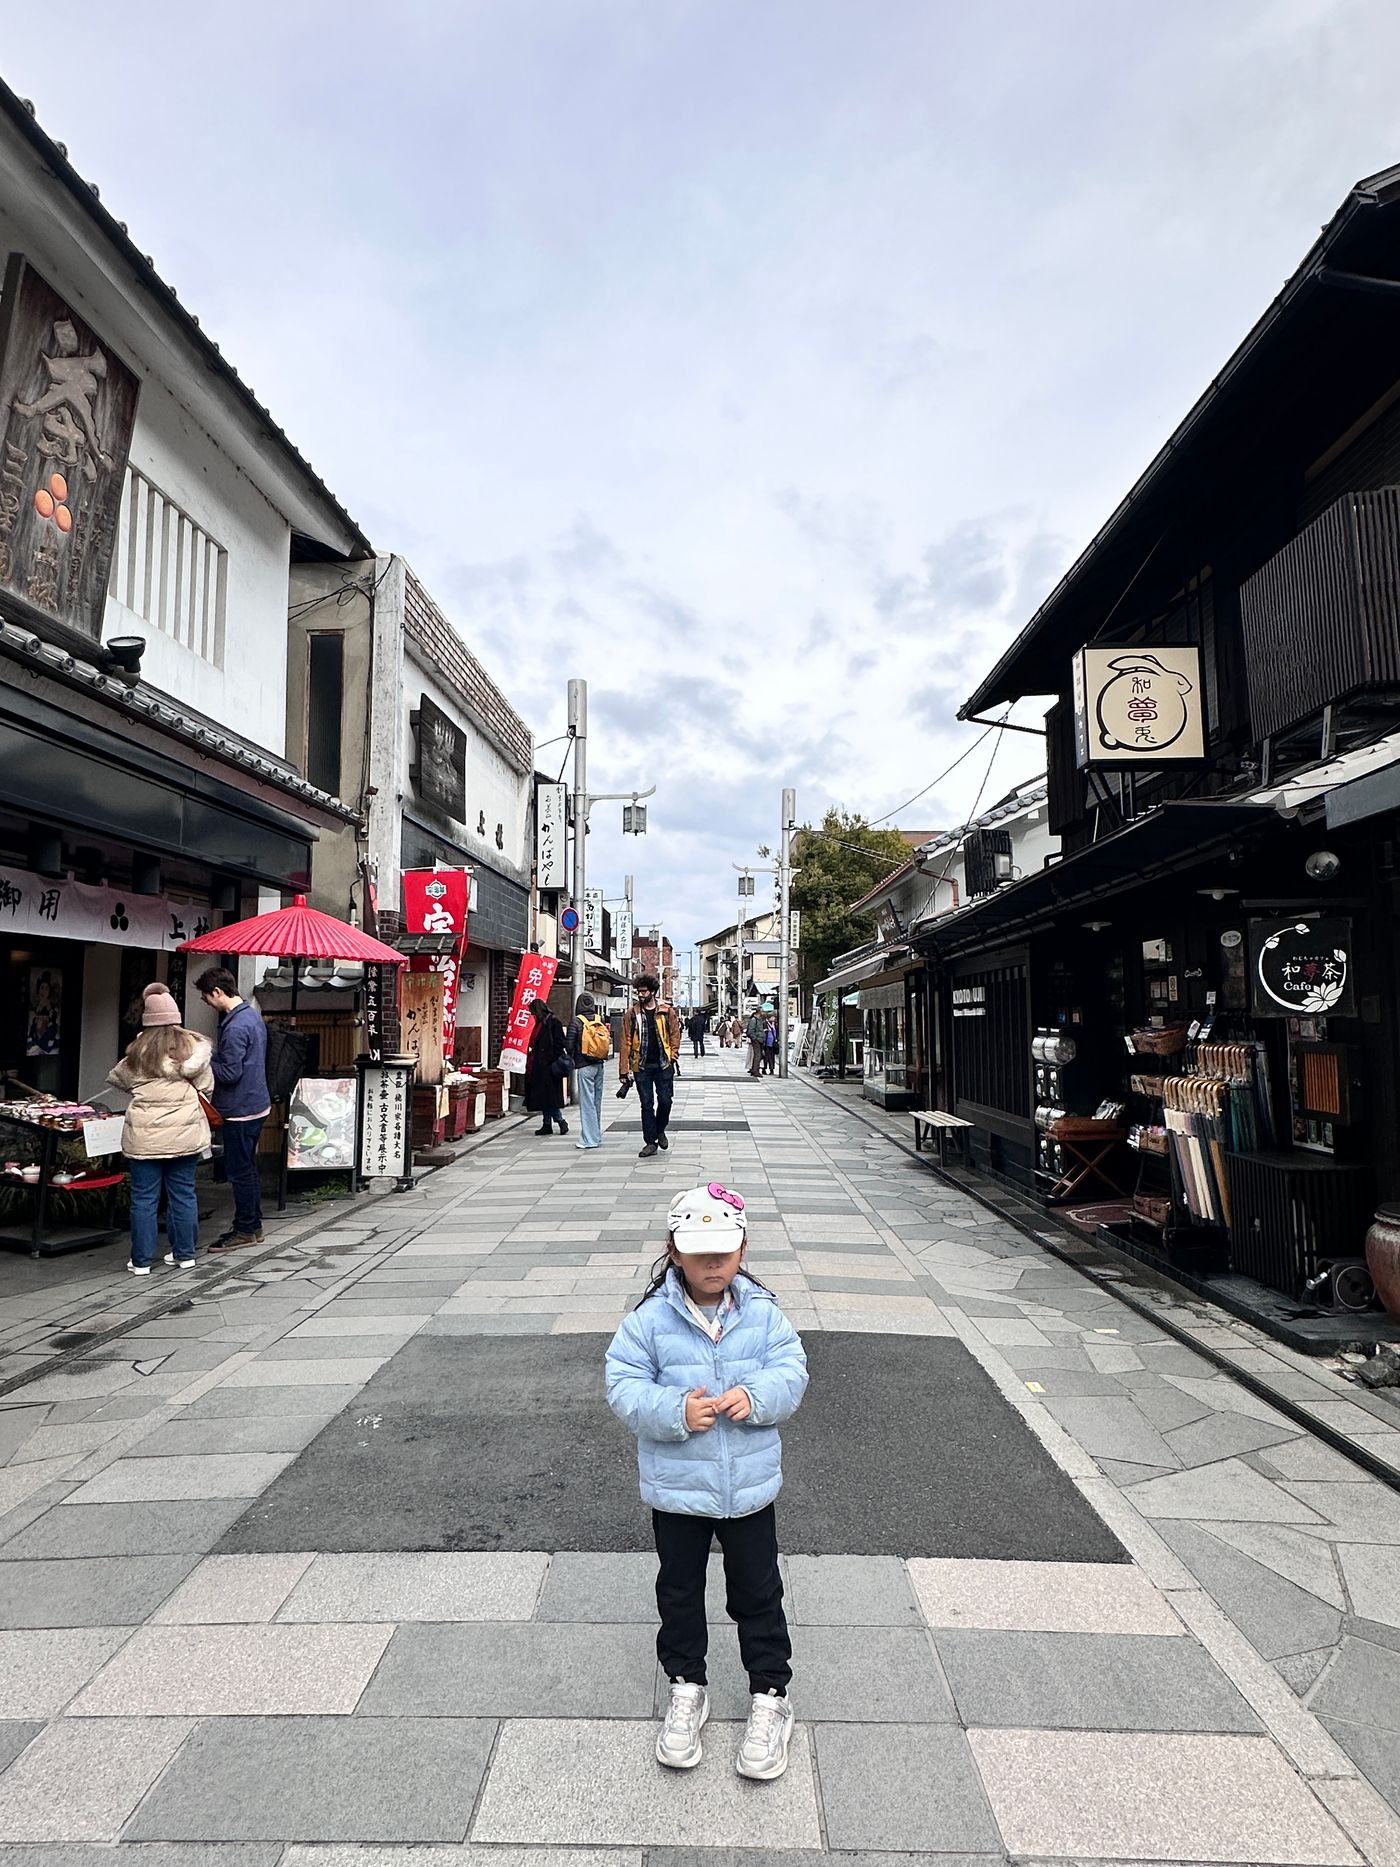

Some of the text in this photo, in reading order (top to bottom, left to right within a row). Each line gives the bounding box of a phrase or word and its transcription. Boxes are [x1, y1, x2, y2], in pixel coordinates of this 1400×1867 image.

[1281, 962, 1342, 982] 和夢茶
[1283, 981, 1312, 991] Cafe
[514, 967, 543, 1028] 免税店
